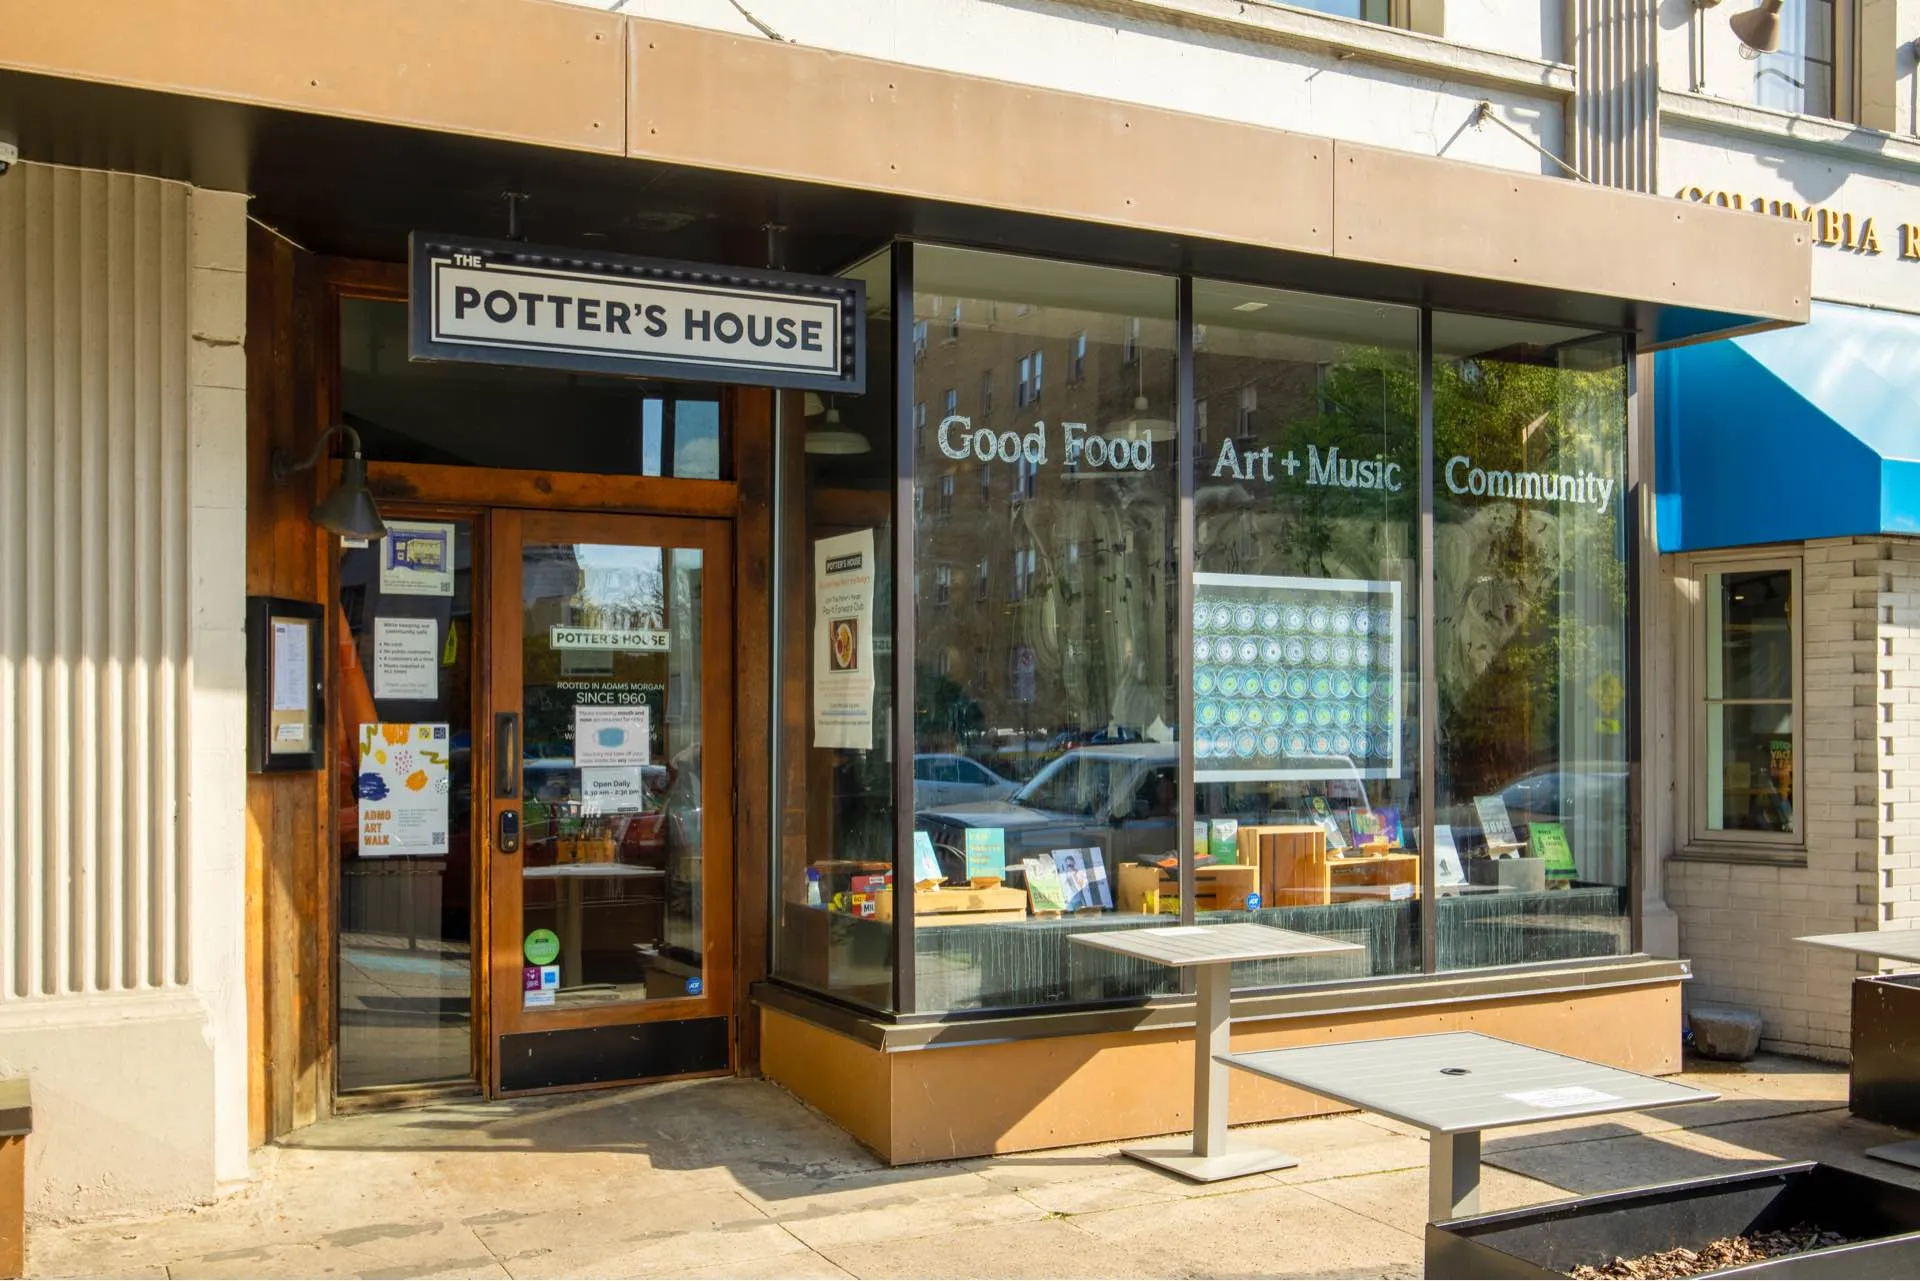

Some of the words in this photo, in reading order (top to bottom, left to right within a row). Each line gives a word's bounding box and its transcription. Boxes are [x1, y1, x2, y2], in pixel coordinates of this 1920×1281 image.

[453, 253, 482, 268] THE
[454, 285, 668, 338] POTTER'S
[684, 307, 823, 352] HOUSE
[936, 414, 1048, 465] Good
[1060, 421, 1155, 471] Food
[1211, 437, 1274, 483] Art
[1280, 449, 1301, 477] +
[1306, 443, 1402, 493] Music
[1444, 455, 1615, 514] Community
[556, 631, 619, 645] POTTER'S
[556, 681, 591, 690] ROOTED
[601, 682, 629, 690] ADAMS
[630, 683, 665, 691] MORGAN
[576, 692, 615, 704] SINCE
[617, 692, 646, 704] 1960
[592, 780, 613, 789] Open
[613, 780, 631, 789] Daily
[363, 809, 391, 821] ADMO
[363, 822, 382, 834] ART
[363, 834, 390, 846] WALK
